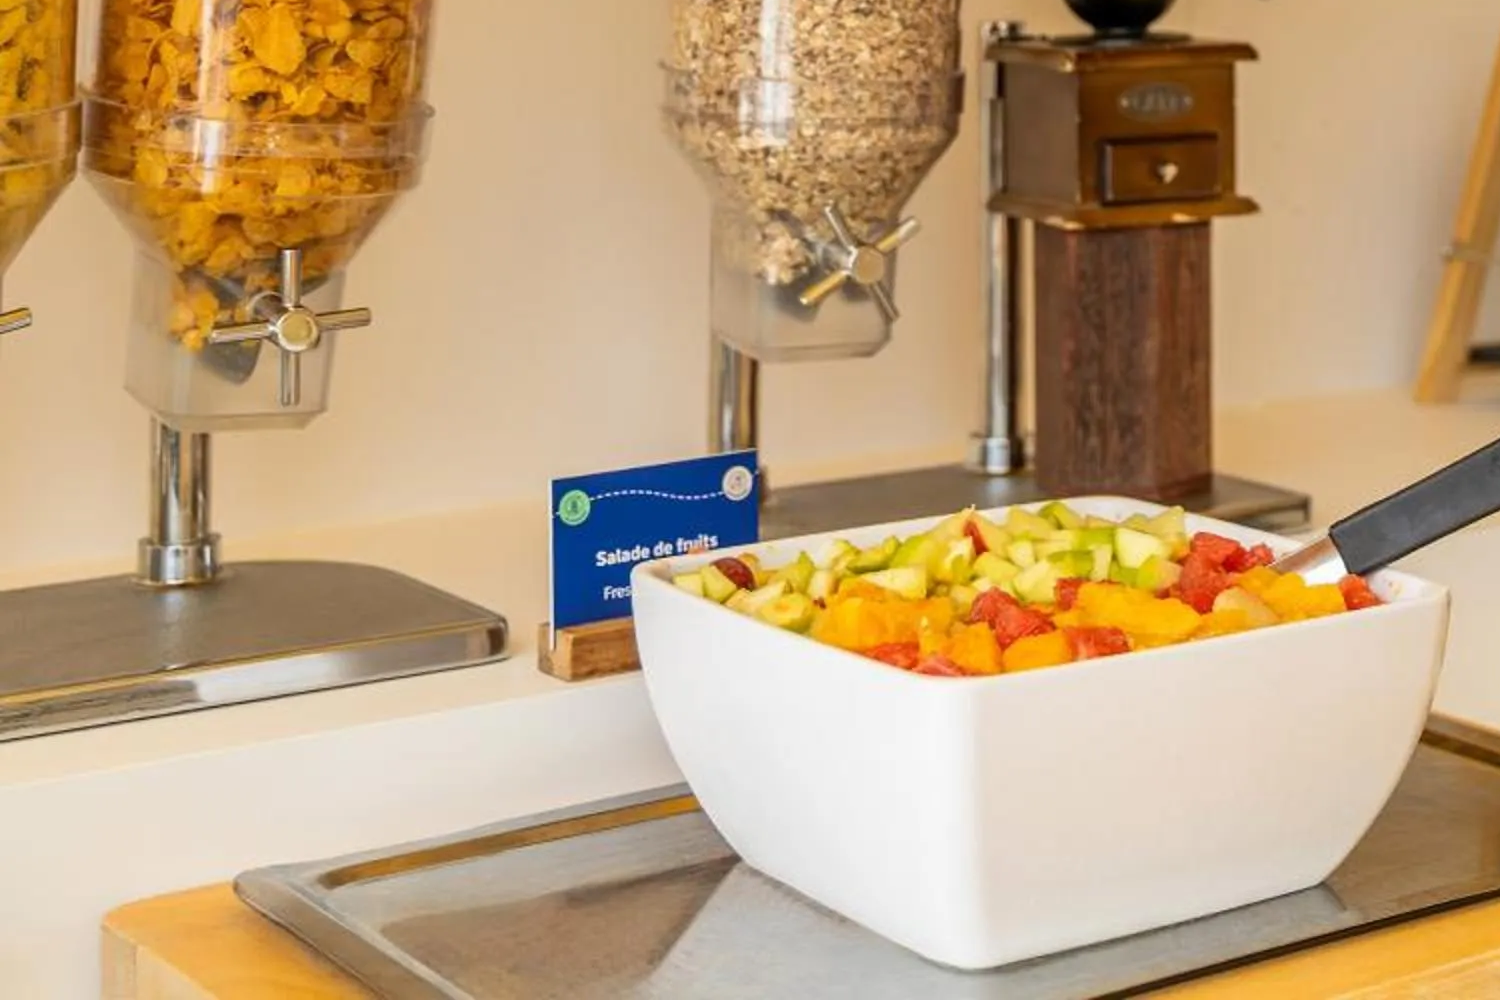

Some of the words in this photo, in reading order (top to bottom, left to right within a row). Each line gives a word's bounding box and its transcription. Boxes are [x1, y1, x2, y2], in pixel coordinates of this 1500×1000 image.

[595, 544, 650, 566] Salade
[653, 540, 673, 556] de
[603, 585, 633, 600] Fres
